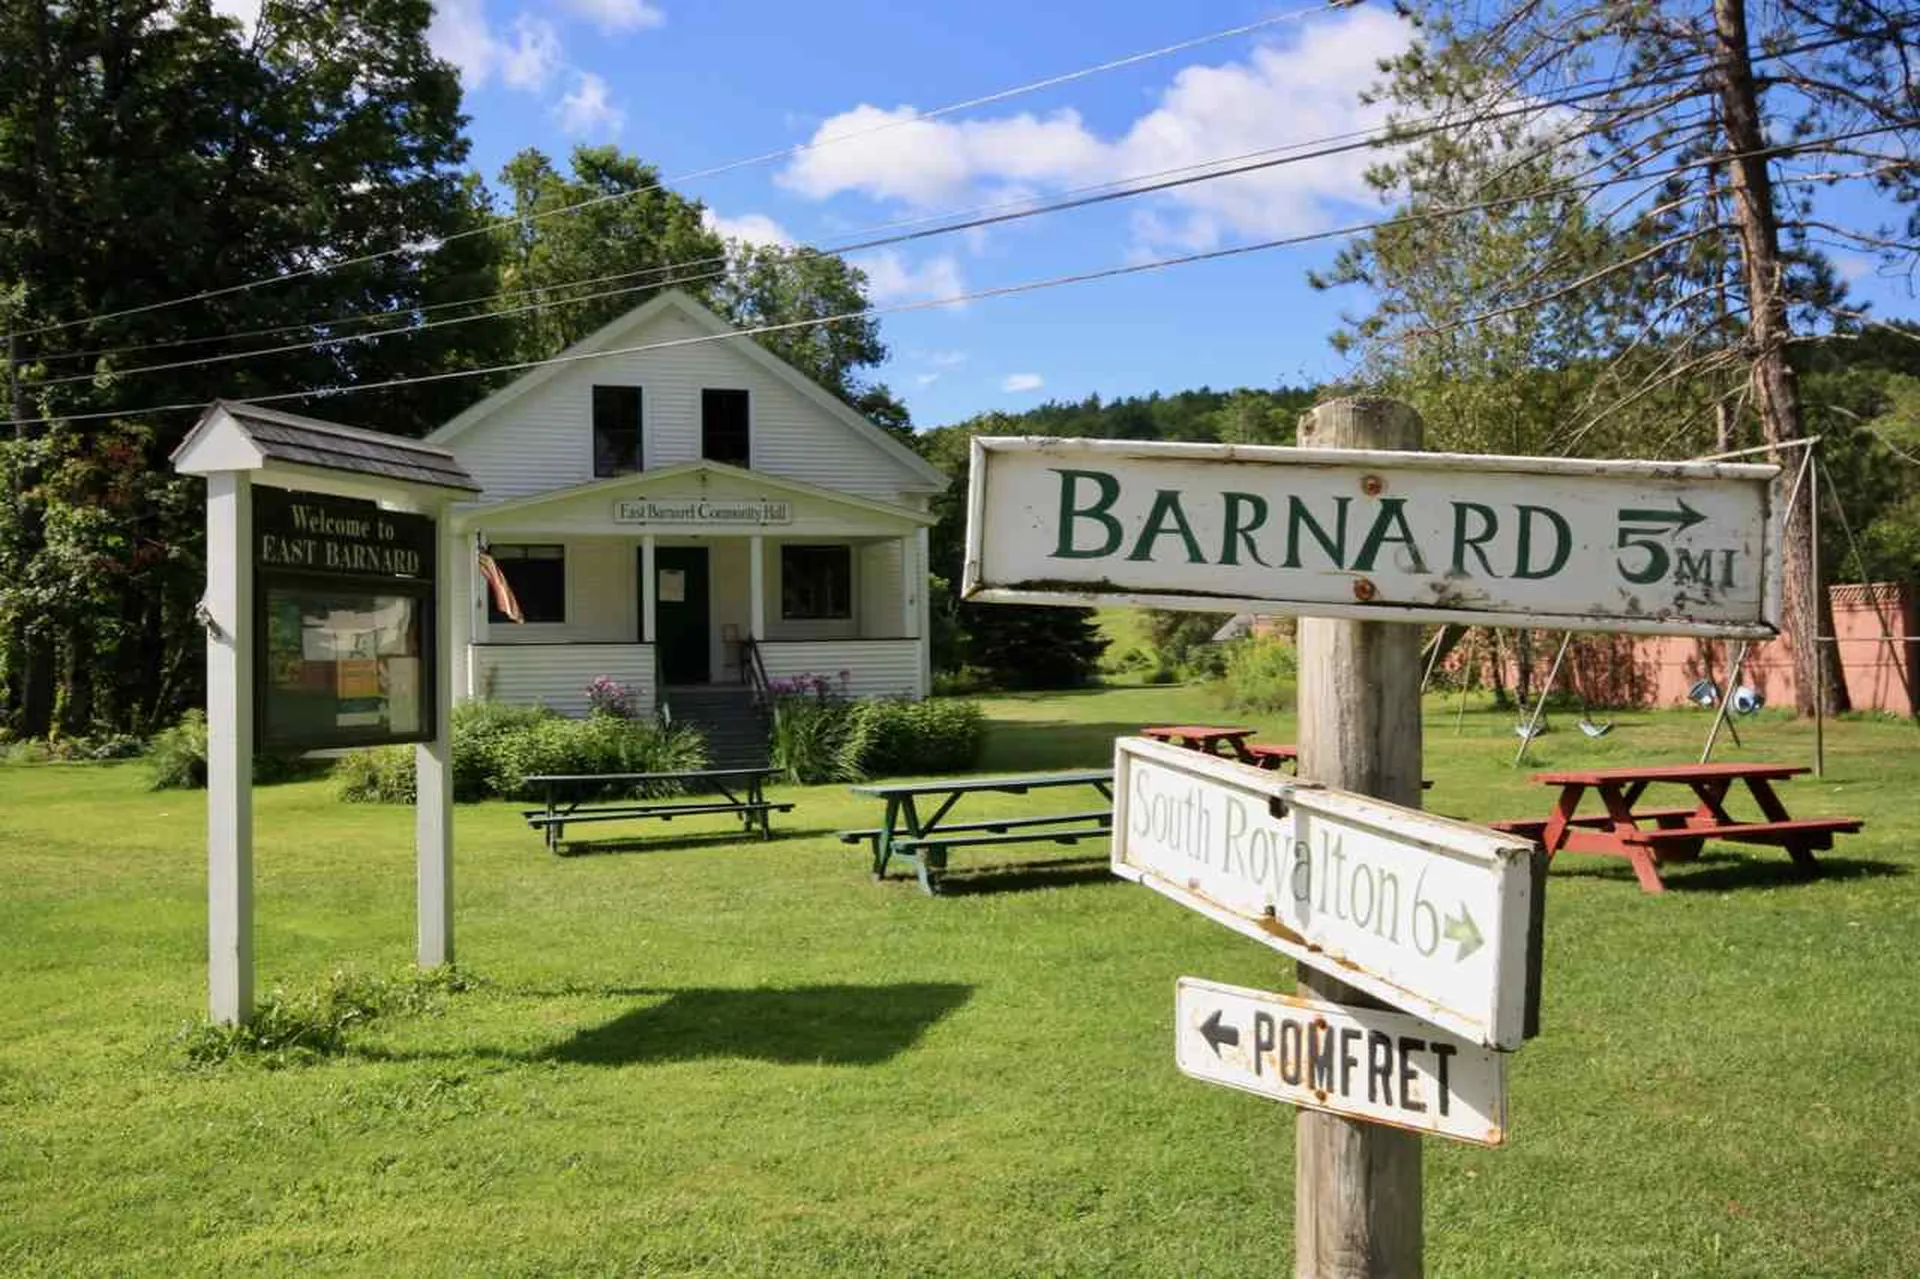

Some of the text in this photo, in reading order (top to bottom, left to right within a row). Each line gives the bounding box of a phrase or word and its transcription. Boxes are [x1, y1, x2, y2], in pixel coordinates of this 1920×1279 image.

[292, 504, 395, 540] Welcome to
[620, 503, 786, 522] East Barnard Community Hall
[1047, 468, 1573, 580] BARNARD
[263, 534, 419, 573] EAST BARNARD
[1133, 769, 1440, 958] South Royalton 6
[1253, 1010, 1457, 1117] POMFRET
